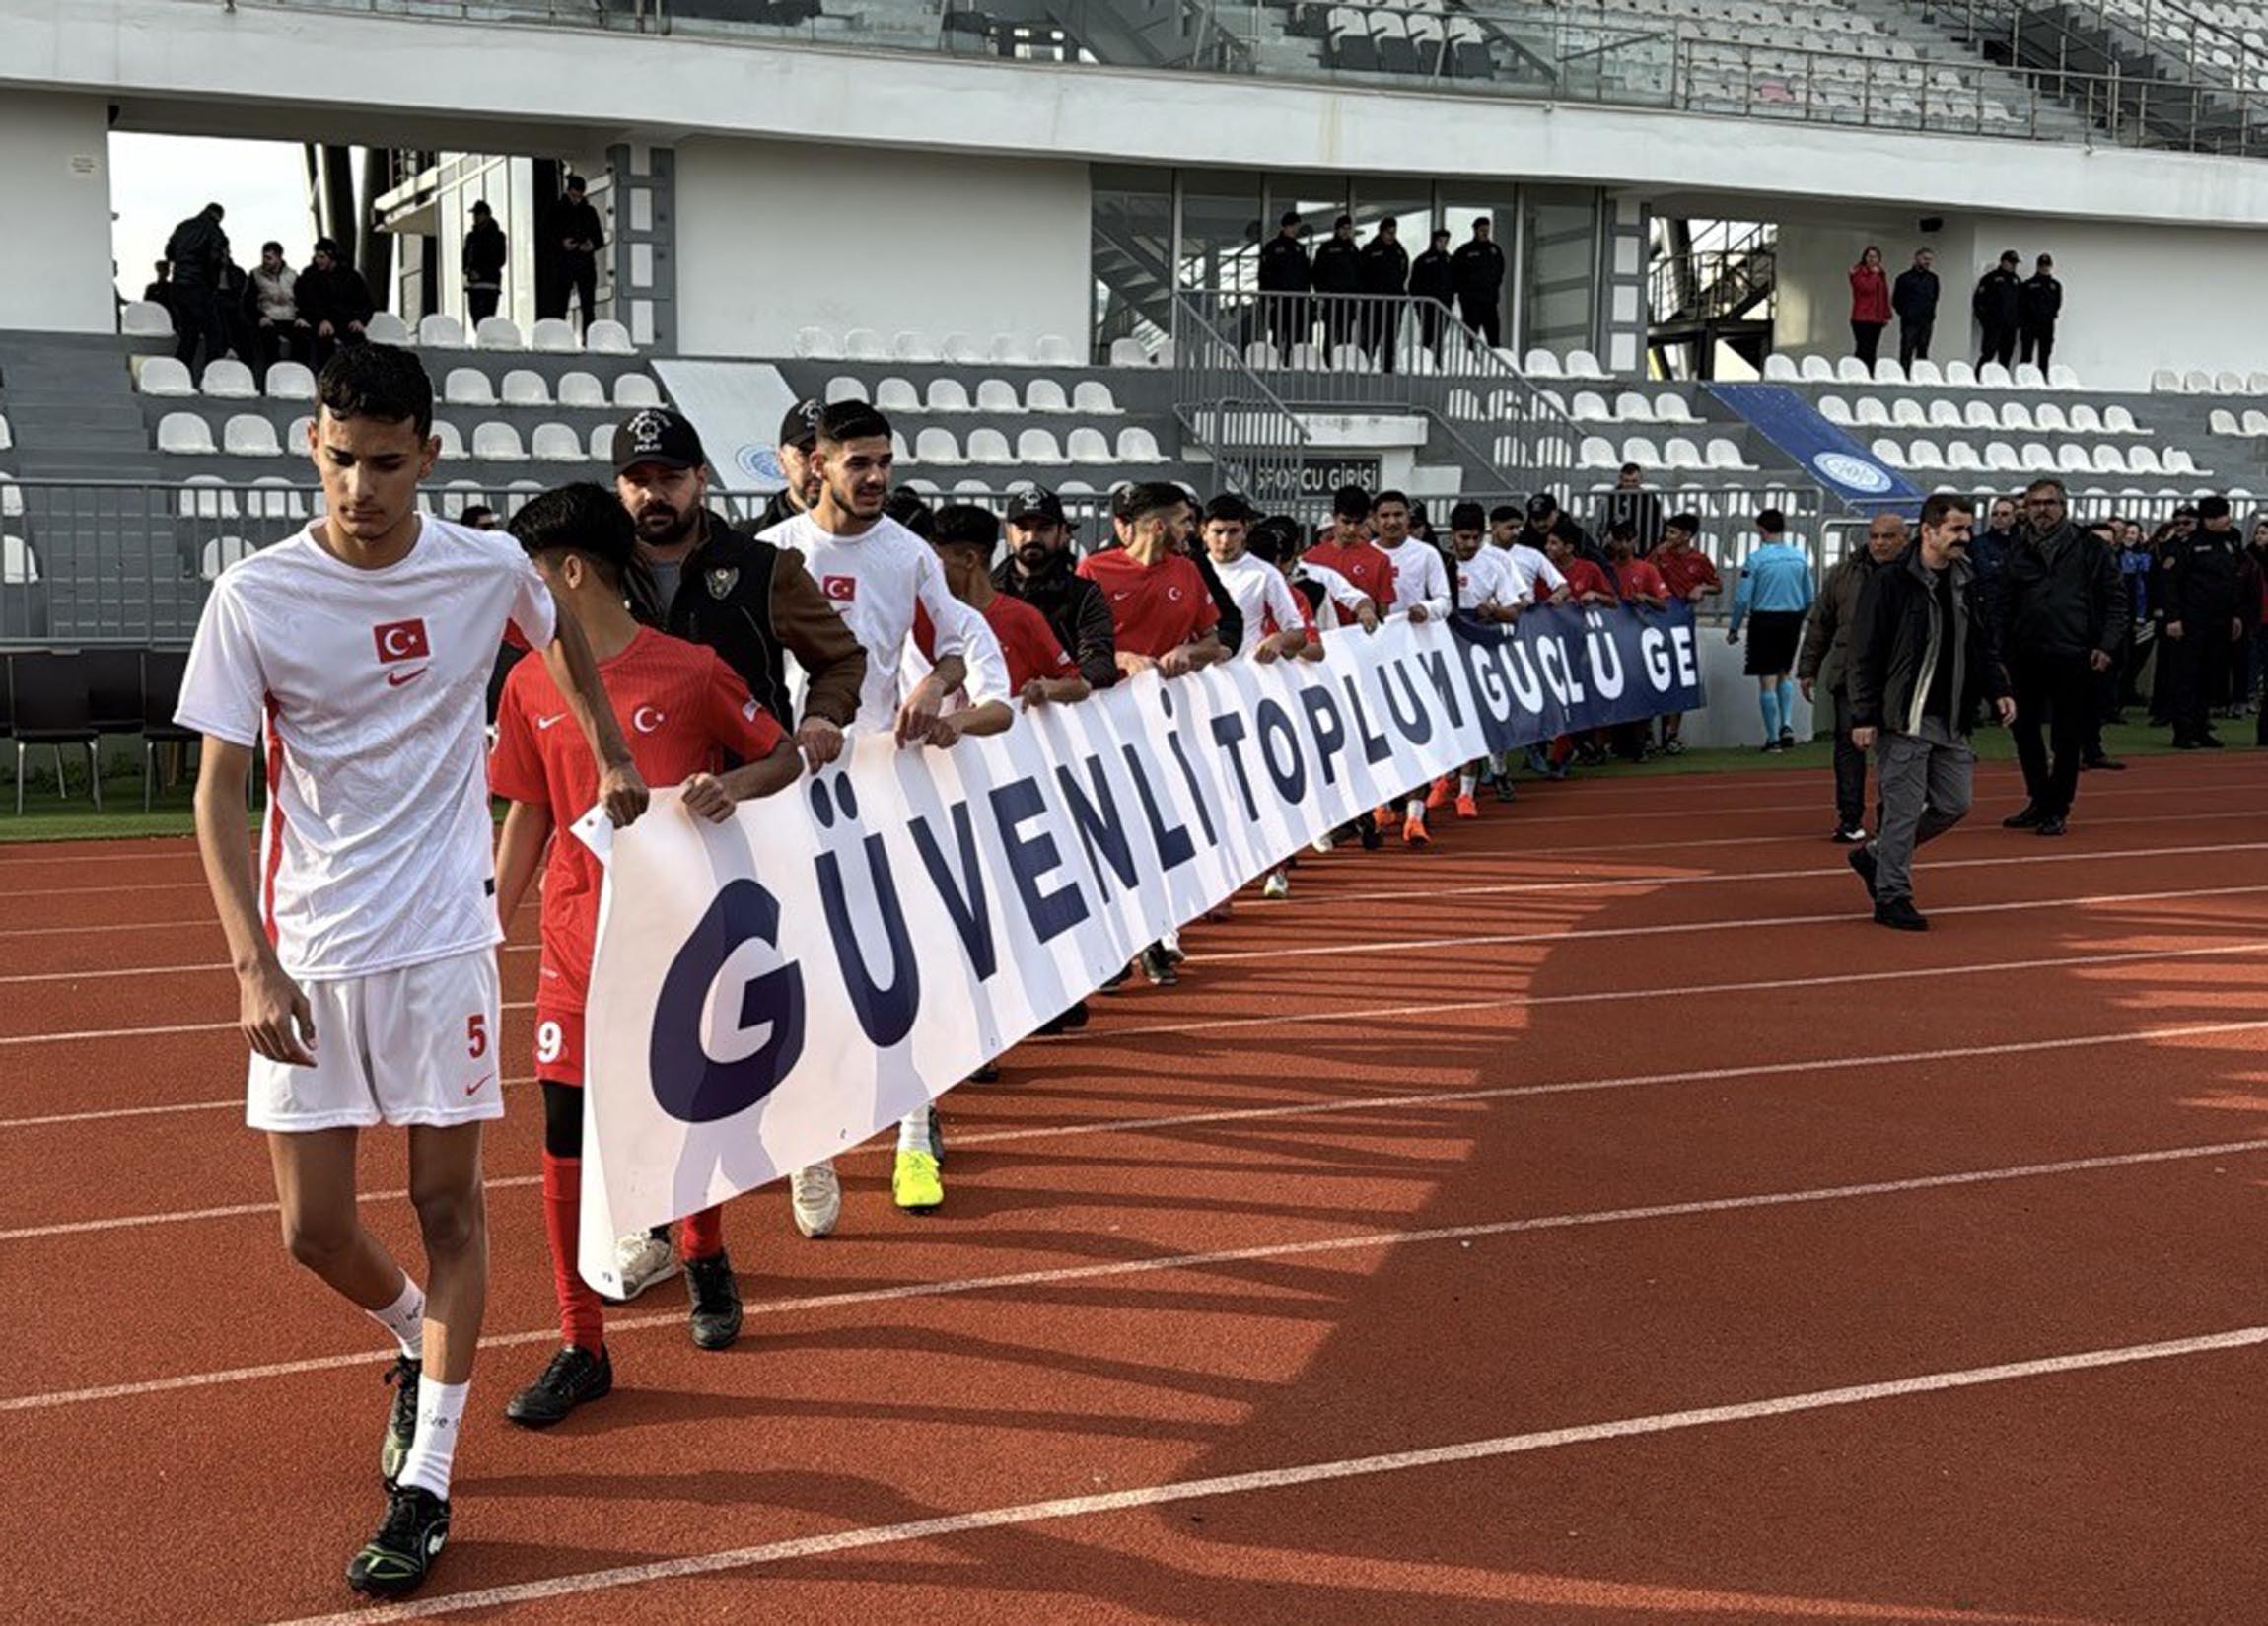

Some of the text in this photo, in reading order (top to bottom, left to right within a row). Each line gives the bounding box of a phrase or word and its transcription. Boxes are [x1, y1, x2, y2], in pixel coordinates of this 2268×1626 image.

[650, 686, 1219, 1124] GÜVENLİ
[1641, 624, 1697, 692] GE
[467, 1014, 486, 1059] 5
[536, 1020, 562, 1063] 9
